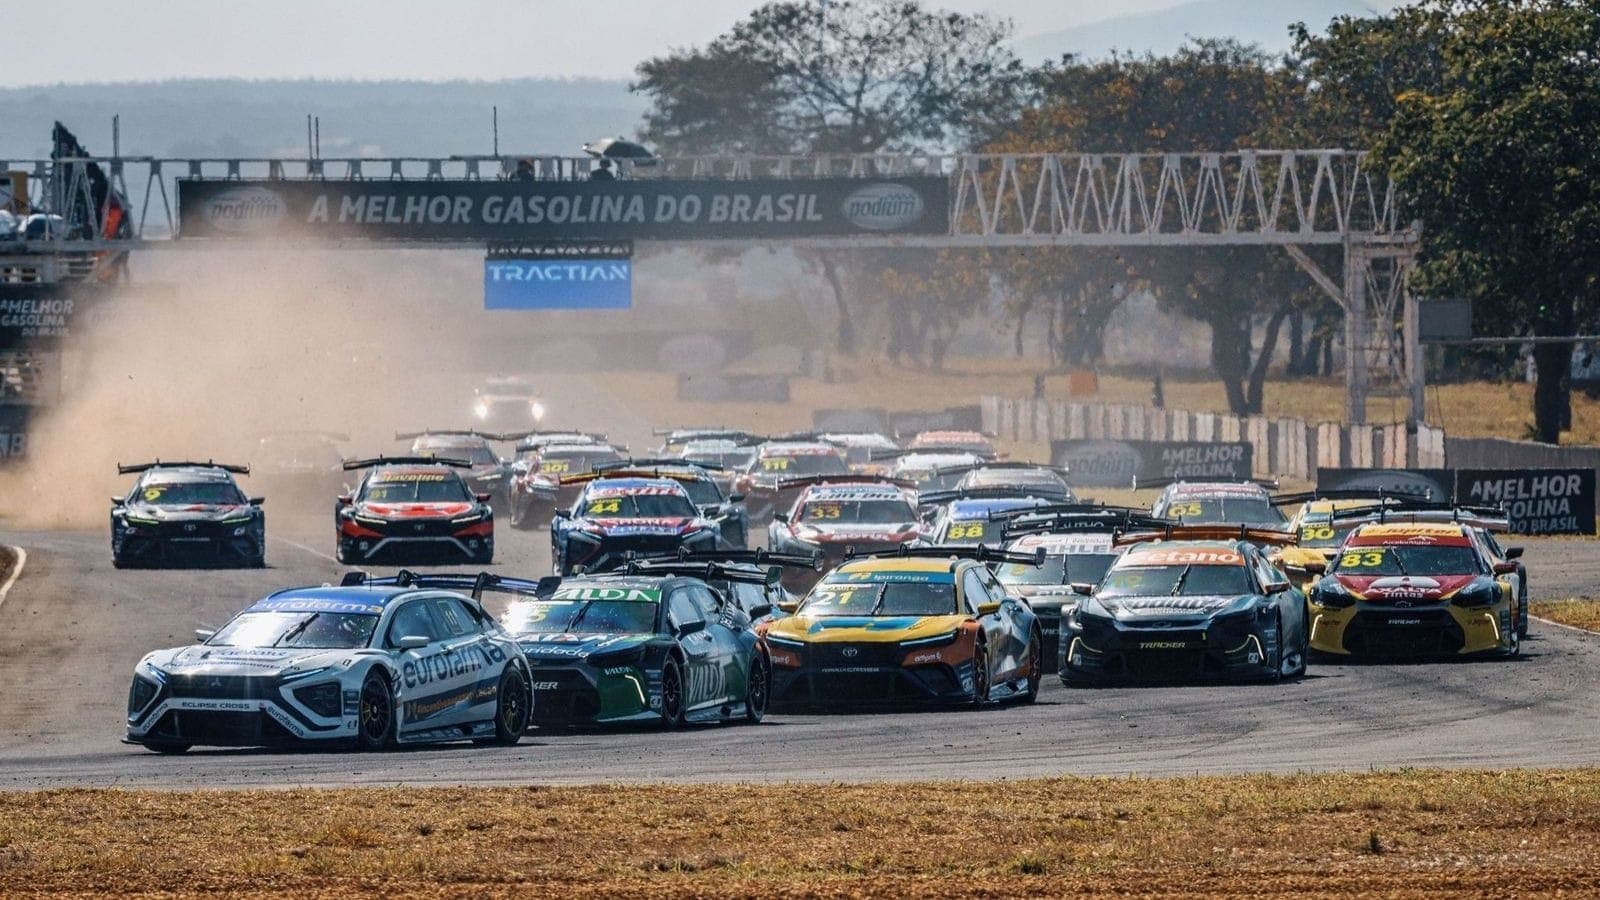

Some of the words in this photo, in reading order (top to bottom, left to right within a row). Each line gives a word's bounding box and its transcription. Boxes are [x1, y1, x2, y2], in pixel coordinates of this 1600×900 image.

[307, 195, 329, 223] A
[338, 195, 473, 224] MELHOR
[481, 195, 645, 223] GASOLINA
[654, 194, 702, 223] DO
[709, 193, 823, 222] BRASIL
[848, 193, 915, 217] podium
[488, 265, 628, 281] TRACTIAN
[144, 487, 160, 501] 9
[588, 502, 619, 513] 44
[810, 507, 841, 519] 33
[1531, 516, 1579, 531] BRASIL
[948, 526, 983, 540] 88
[1302, 528, 1335, 541] 30
[1340, 552, 1383, 567] 83
[1139, 641, 1186, 649] TRACKER
[403, 638, 508, 689] eurofarma
[220, 702, 250, 710] CROSS
[268, 706, 305, 737] eurofarma
